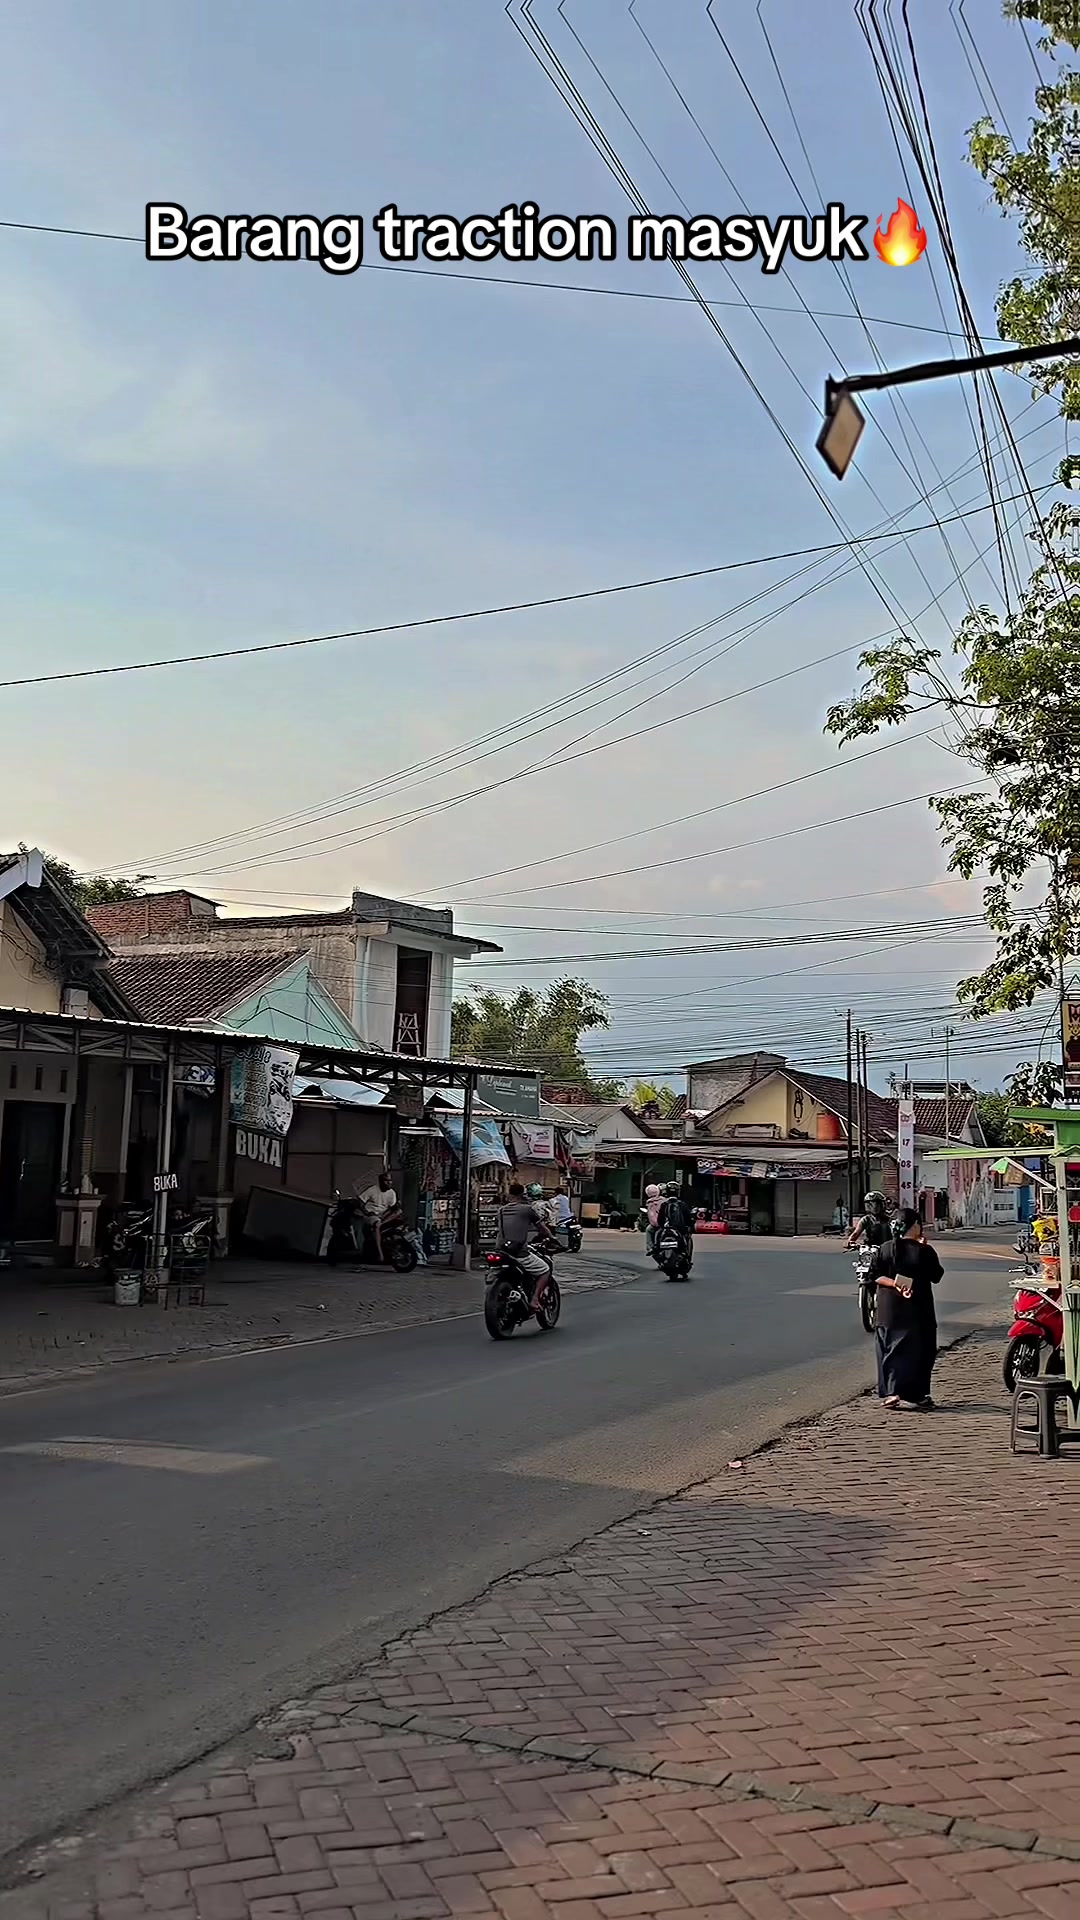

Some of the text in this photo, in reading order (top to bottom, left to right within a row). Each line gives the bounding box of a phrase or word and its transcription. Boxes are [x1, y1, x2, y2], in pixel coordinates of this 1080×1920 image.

[902, 1138, 911, 1147] 17
[235, 1130, 282, 1167] BUKA
[900, 1160, 912, 1169] 08
[153, 1173, 178, 1192] BUKA
[901, 1181, 912, 1189] 45
